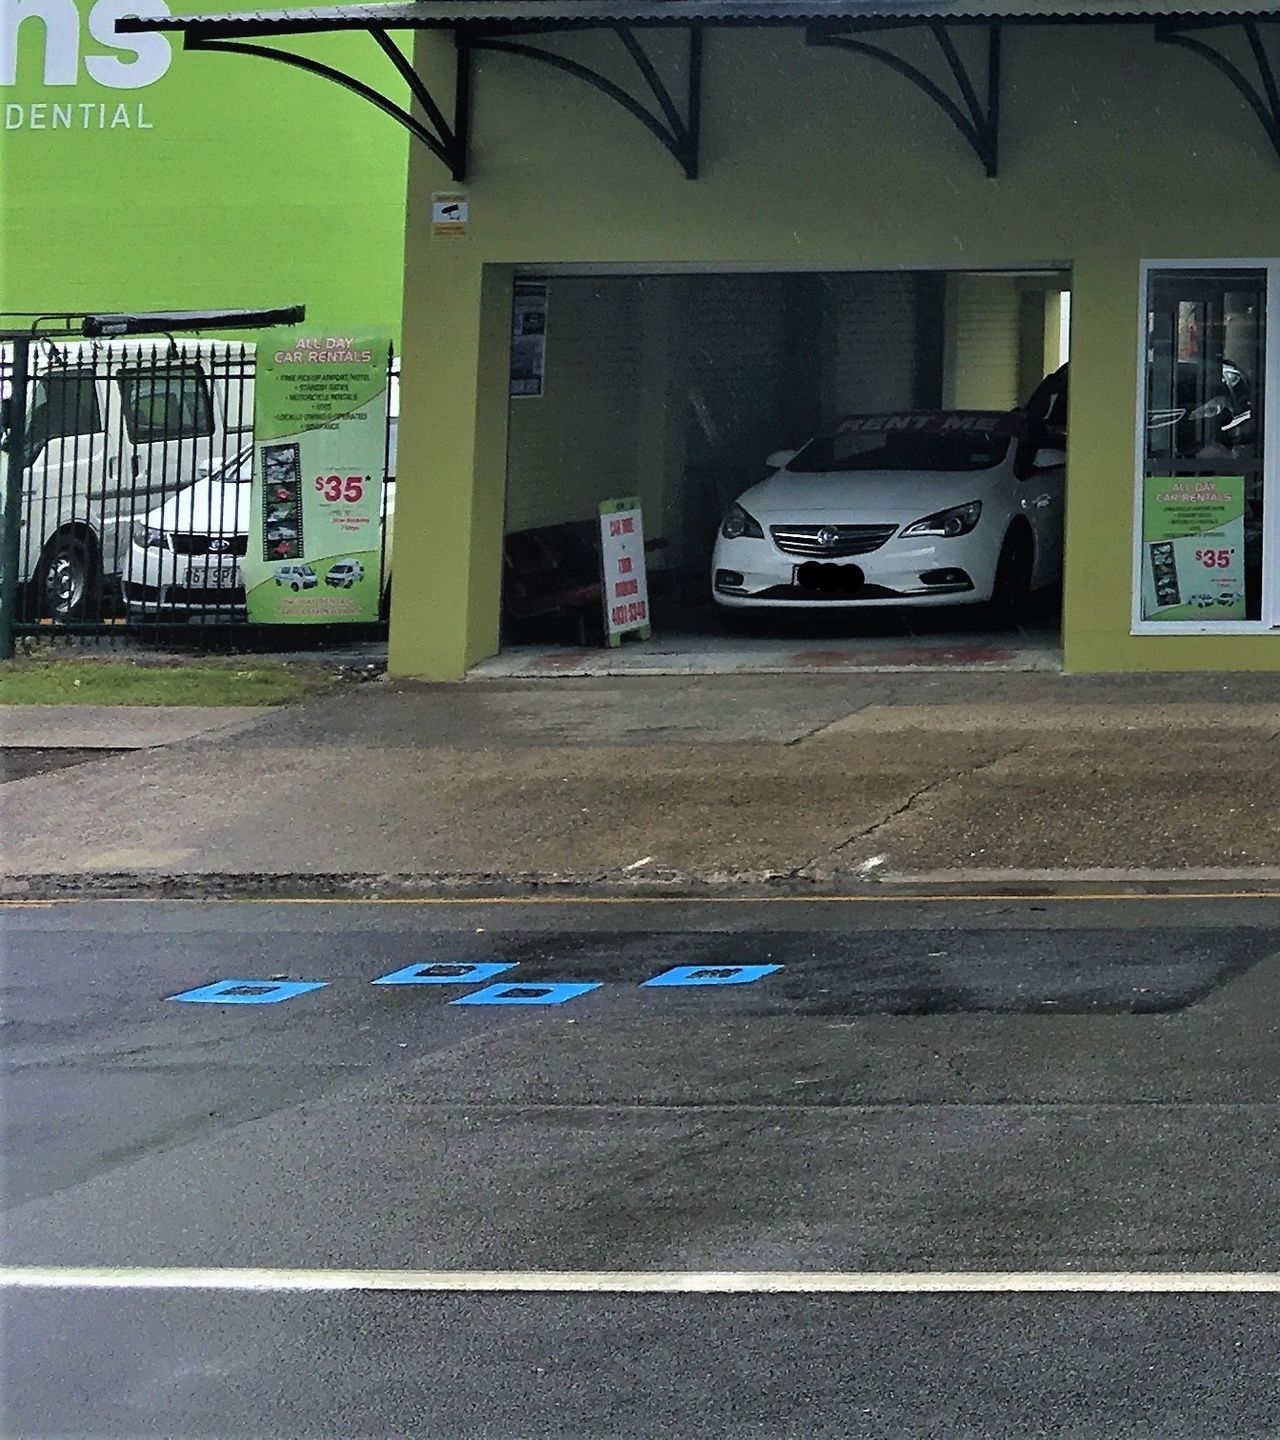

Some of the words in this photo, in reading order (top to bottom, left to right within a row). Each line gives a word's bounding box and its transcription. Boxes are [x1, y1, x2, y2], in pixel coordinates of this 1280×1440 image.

[5, 103, 154, 130] DENTIAL
[295, 338, 320, 349] ALL
[326, 338, 354, 349] DAY
[274, 351, 302, 363] CAR
[308, 351, 371, 362] RENTALS
[837, 415, 935, 433] RENT
[941, 415, 1002, 433] ME
[1195, 482, 1216, 491] DAY
[1156, 493, 1178, 502] CAR
[1182, 493, 1232, 502] RENTALS
